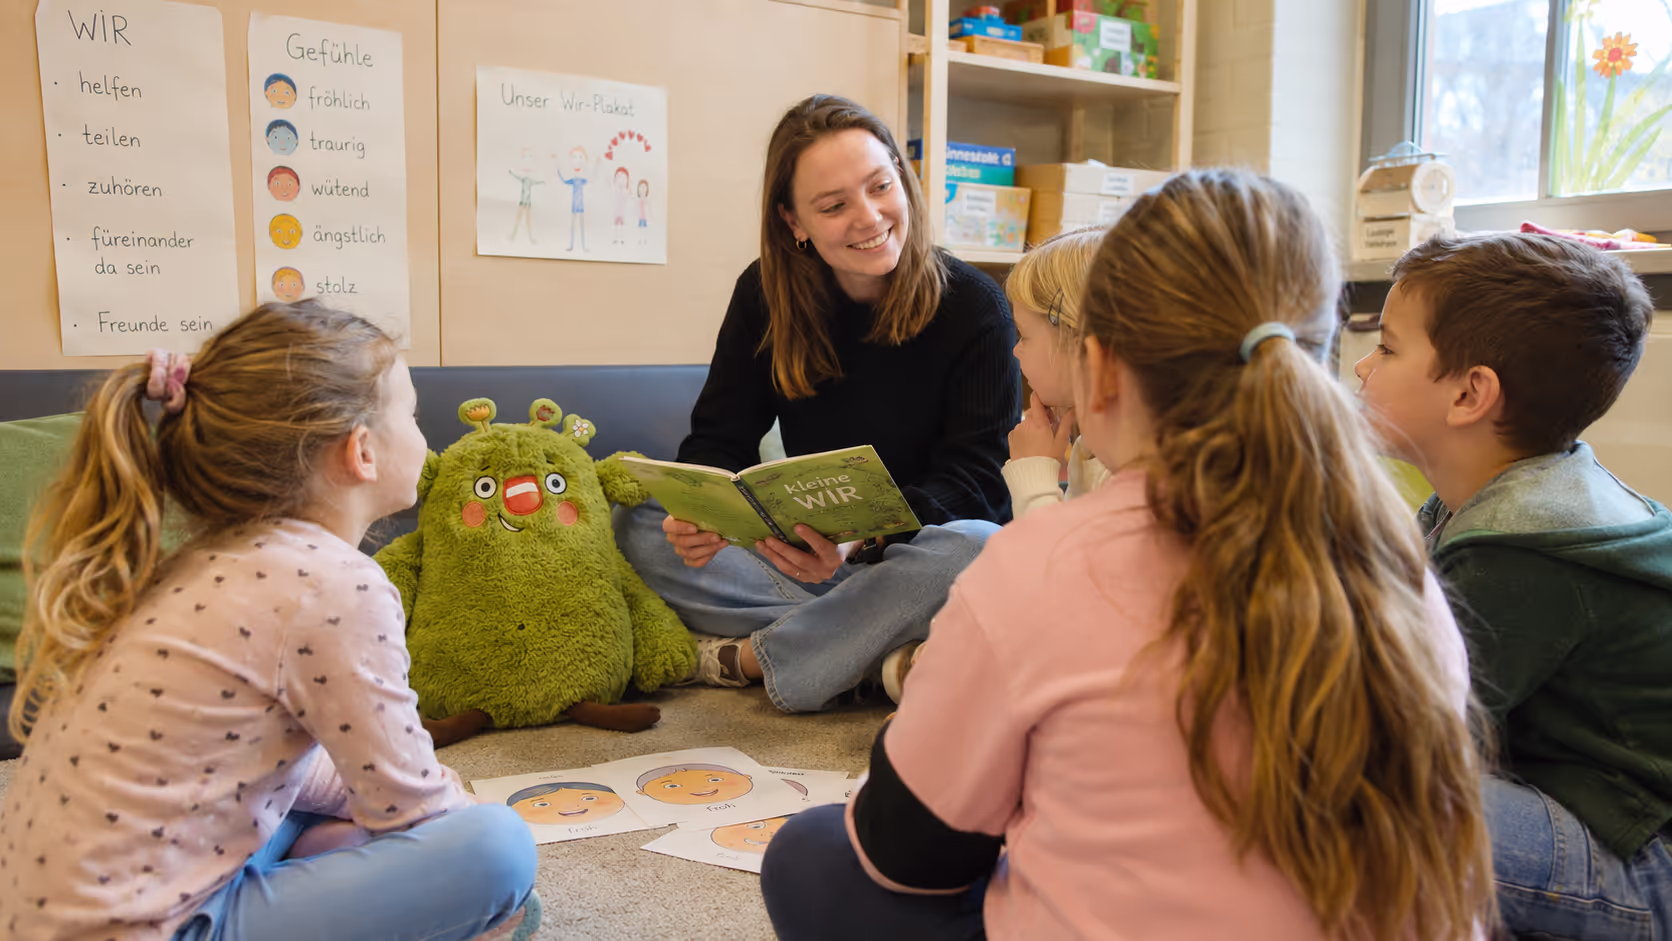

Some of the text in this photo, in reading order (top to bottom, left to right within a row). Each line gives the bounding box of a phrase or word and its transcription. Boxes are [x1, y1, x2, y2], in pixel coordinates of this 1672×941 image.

[285, 32, 375, 68] Gefühle
[78, 70, 143, 101] helfen
[307, 85, 371, 111] fröhlich
[500, 82, 635, 118] Unser Wir-Plakat
[81, 123, 142, 148] teilen
[309, 130, 366, 160] traurig
[87, 175, 163, 197] zuhören
[309, 177, 371, 199] wütend
[90, 224, 194, 251] füreinander
[312, 223, 387, 250] ängstlich
[93, 258, 161, 277] da sein
[314, 274, 359, 296] stolz
[97, 310, 213, 333] Freunde sein
[783, 474, 852, 495] kleine
